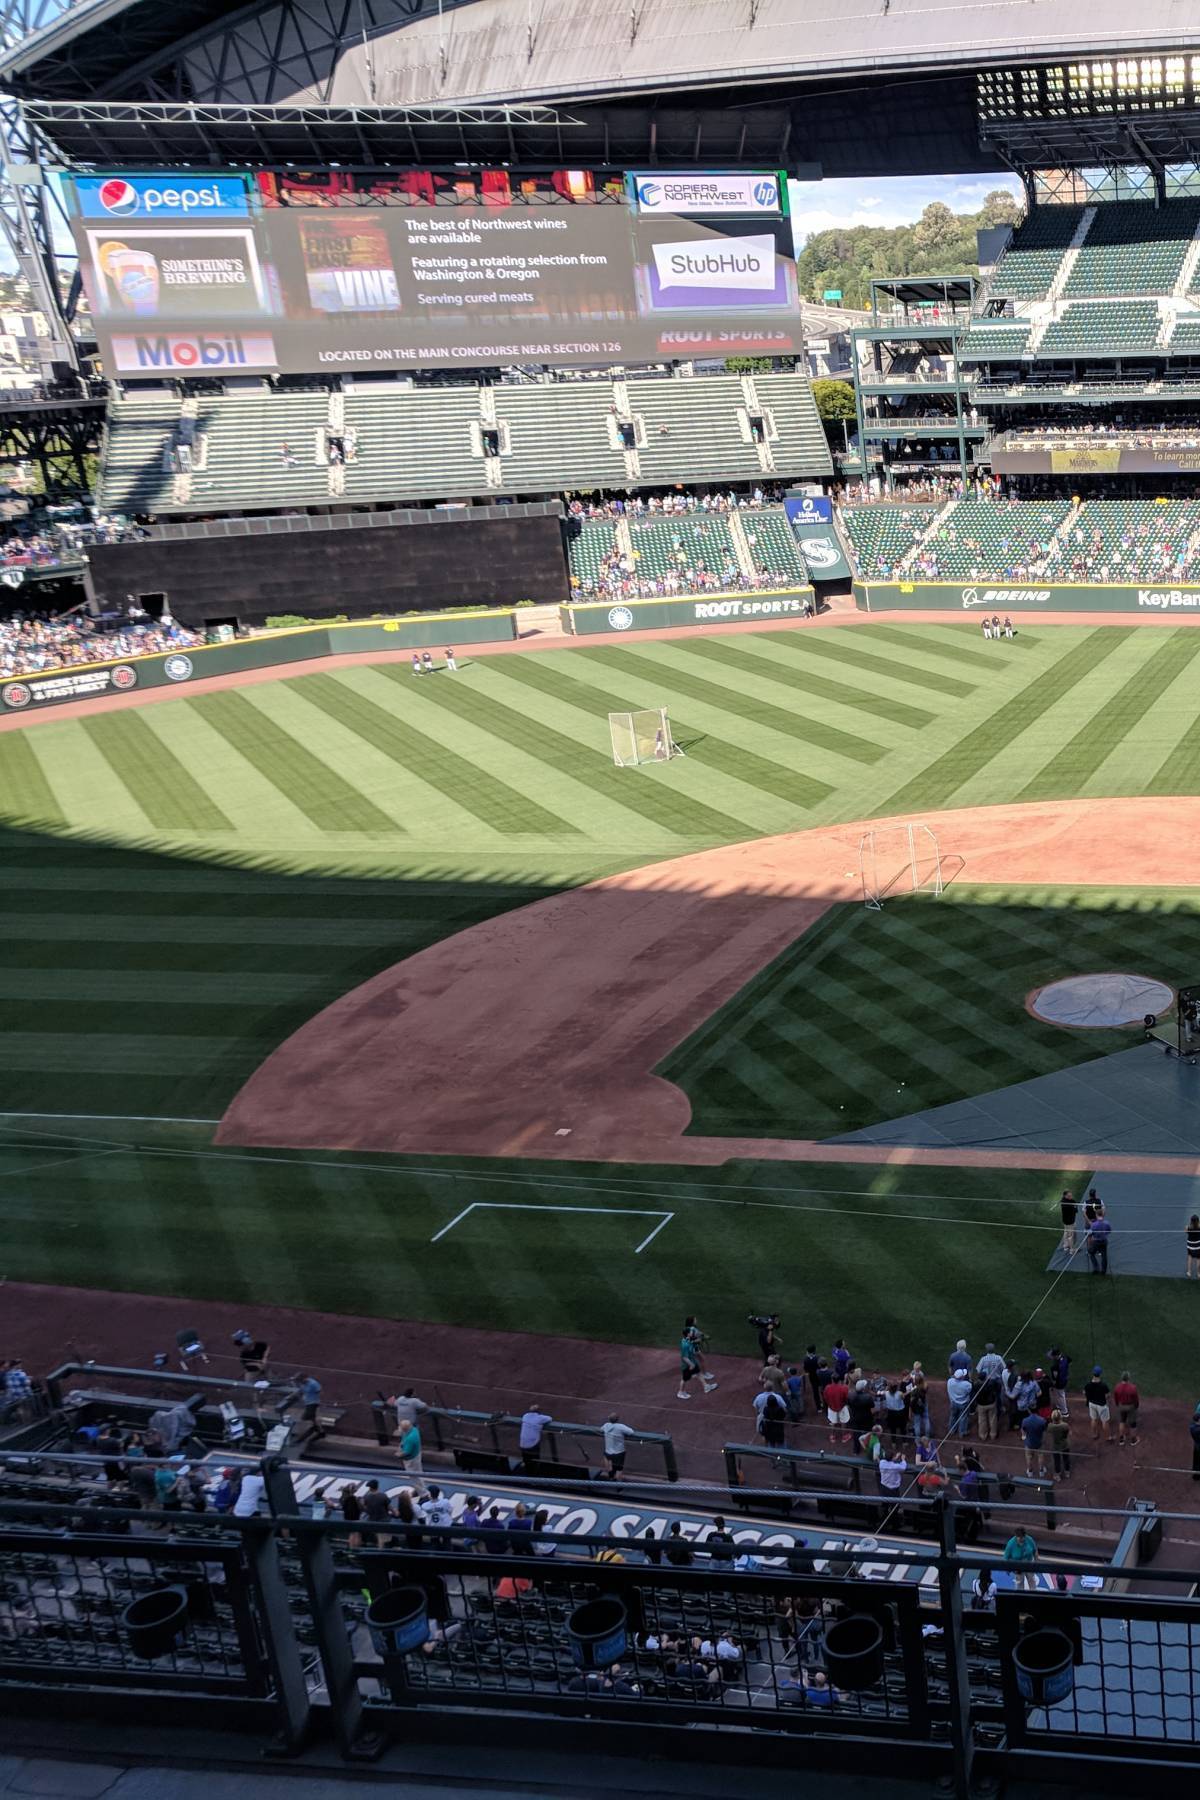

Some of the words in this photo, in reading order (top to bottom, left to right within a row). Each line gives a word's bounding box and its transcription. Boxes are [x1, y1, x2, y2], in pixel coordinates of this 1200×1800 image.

[663, 184, 718, 192] COPIERS
[143, 184, 222, 212] pepsi
[665, 192, 744, 201] NORTHWEST
[404, 219, 428, 231] The
[430, 219, 456, 231] best
[457, 218, 472, 230] of
[472, 218, 532, 230] Northwest
[534, 218, 567, 229] wines
[407, 234, 428, 244] are
[429, 232, 482, 243] available
[161, 258, 244, 272] SOMETHING'S
[411, 256, 468, 269] Featuring
[479, 255, 526, 268] rotating
[527, 254, 578, 266] selection
[580, 253, 608, 265] from
[671, 253, 761, 275] StubHub
[163, 271, 247, 284] BREWING
[413, 269, 484, 282] Washington
[485, 268, 495, 279] &
[496, 268, 540, 281] Oregon
[417, 293, 463, 306] Serving
[464, 292, 497, 304] cured
[499, 291, 534, 302] meats
[135, 335, 247, 367] Mobil
[318, 350, 372, 362] LOCATED
[374, 350, 393, 360] ON
[395, 349, 417, 359] THE
[419, 347, 449, 358] MAIN
[451, 345, 520, 358] CONCOURSE
[521, 344, 551, 355] NEAR
[553, 343, 600, 354] SECTION
[602, 342, 622, 352] 126
[1153, 452, 1163, 460] To
[1164, 451, 1184, 460] learn
[1178, 460, 1194, 469] Call
[983, 590, 1051, 601] BOEING
[694, 601, 743, 618] ROOT
[290, 1472, 521, 1524] WELCME
